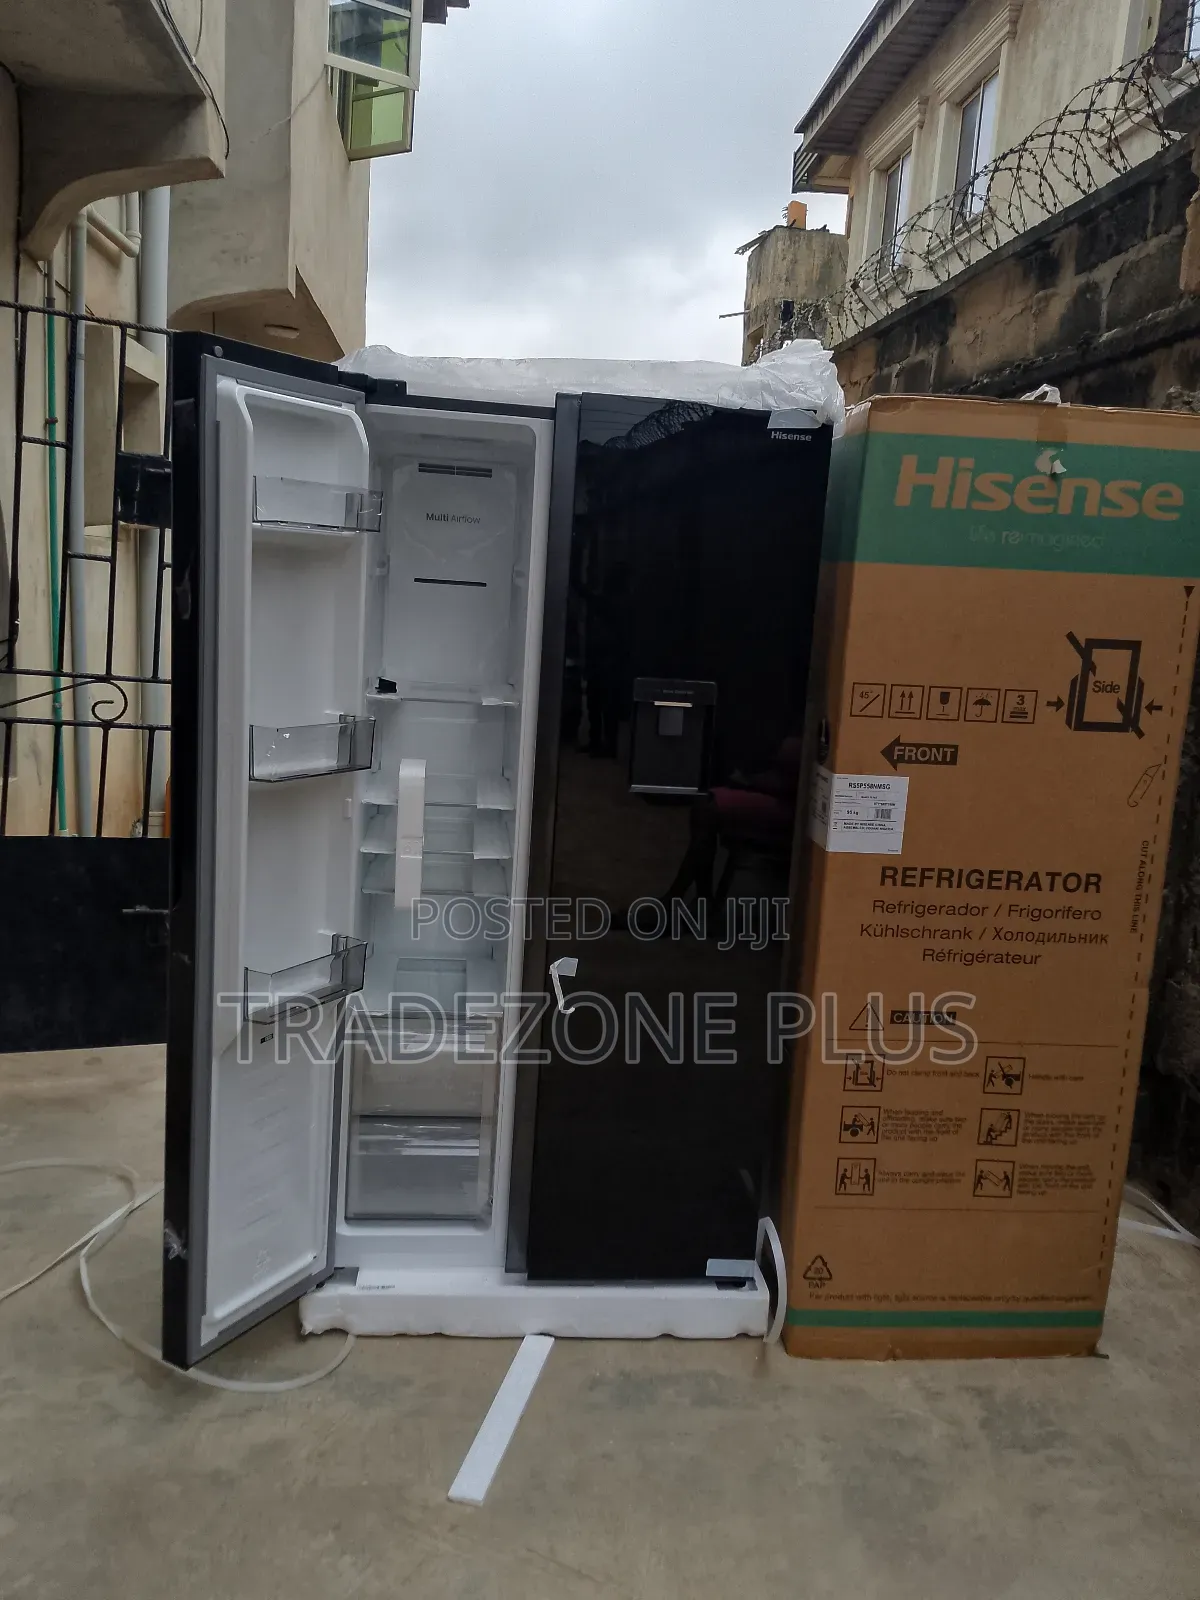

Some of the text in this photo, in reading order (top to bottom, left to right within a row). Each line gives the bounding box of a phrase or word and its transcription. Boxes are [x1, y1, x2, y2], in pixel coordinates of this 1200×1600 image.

[771, 431, 812, 441] Hisense
[894, 454, 1184, 521] Hisense
[426, 512, 449, 522] Multi
[1092, 680, 1120, 693] Side
[1016, 694, 1025, 706] 3
[893, 746, 955, 763] FRONT
[880, 866, 1102, 894] REFRIGERATOR
[1130, 841, 1150, 933] CUT ALONG THIS LINE
[872, 900, 988, 918] Refrigerador
[994, 904, 1002, 917] /
[860, 924, 1109, 946] Kühlschrank / Холодильник
[922, 948, 1042, 966] Réfrigérateur
[893, 1012, 954, 1024] CAUTION
